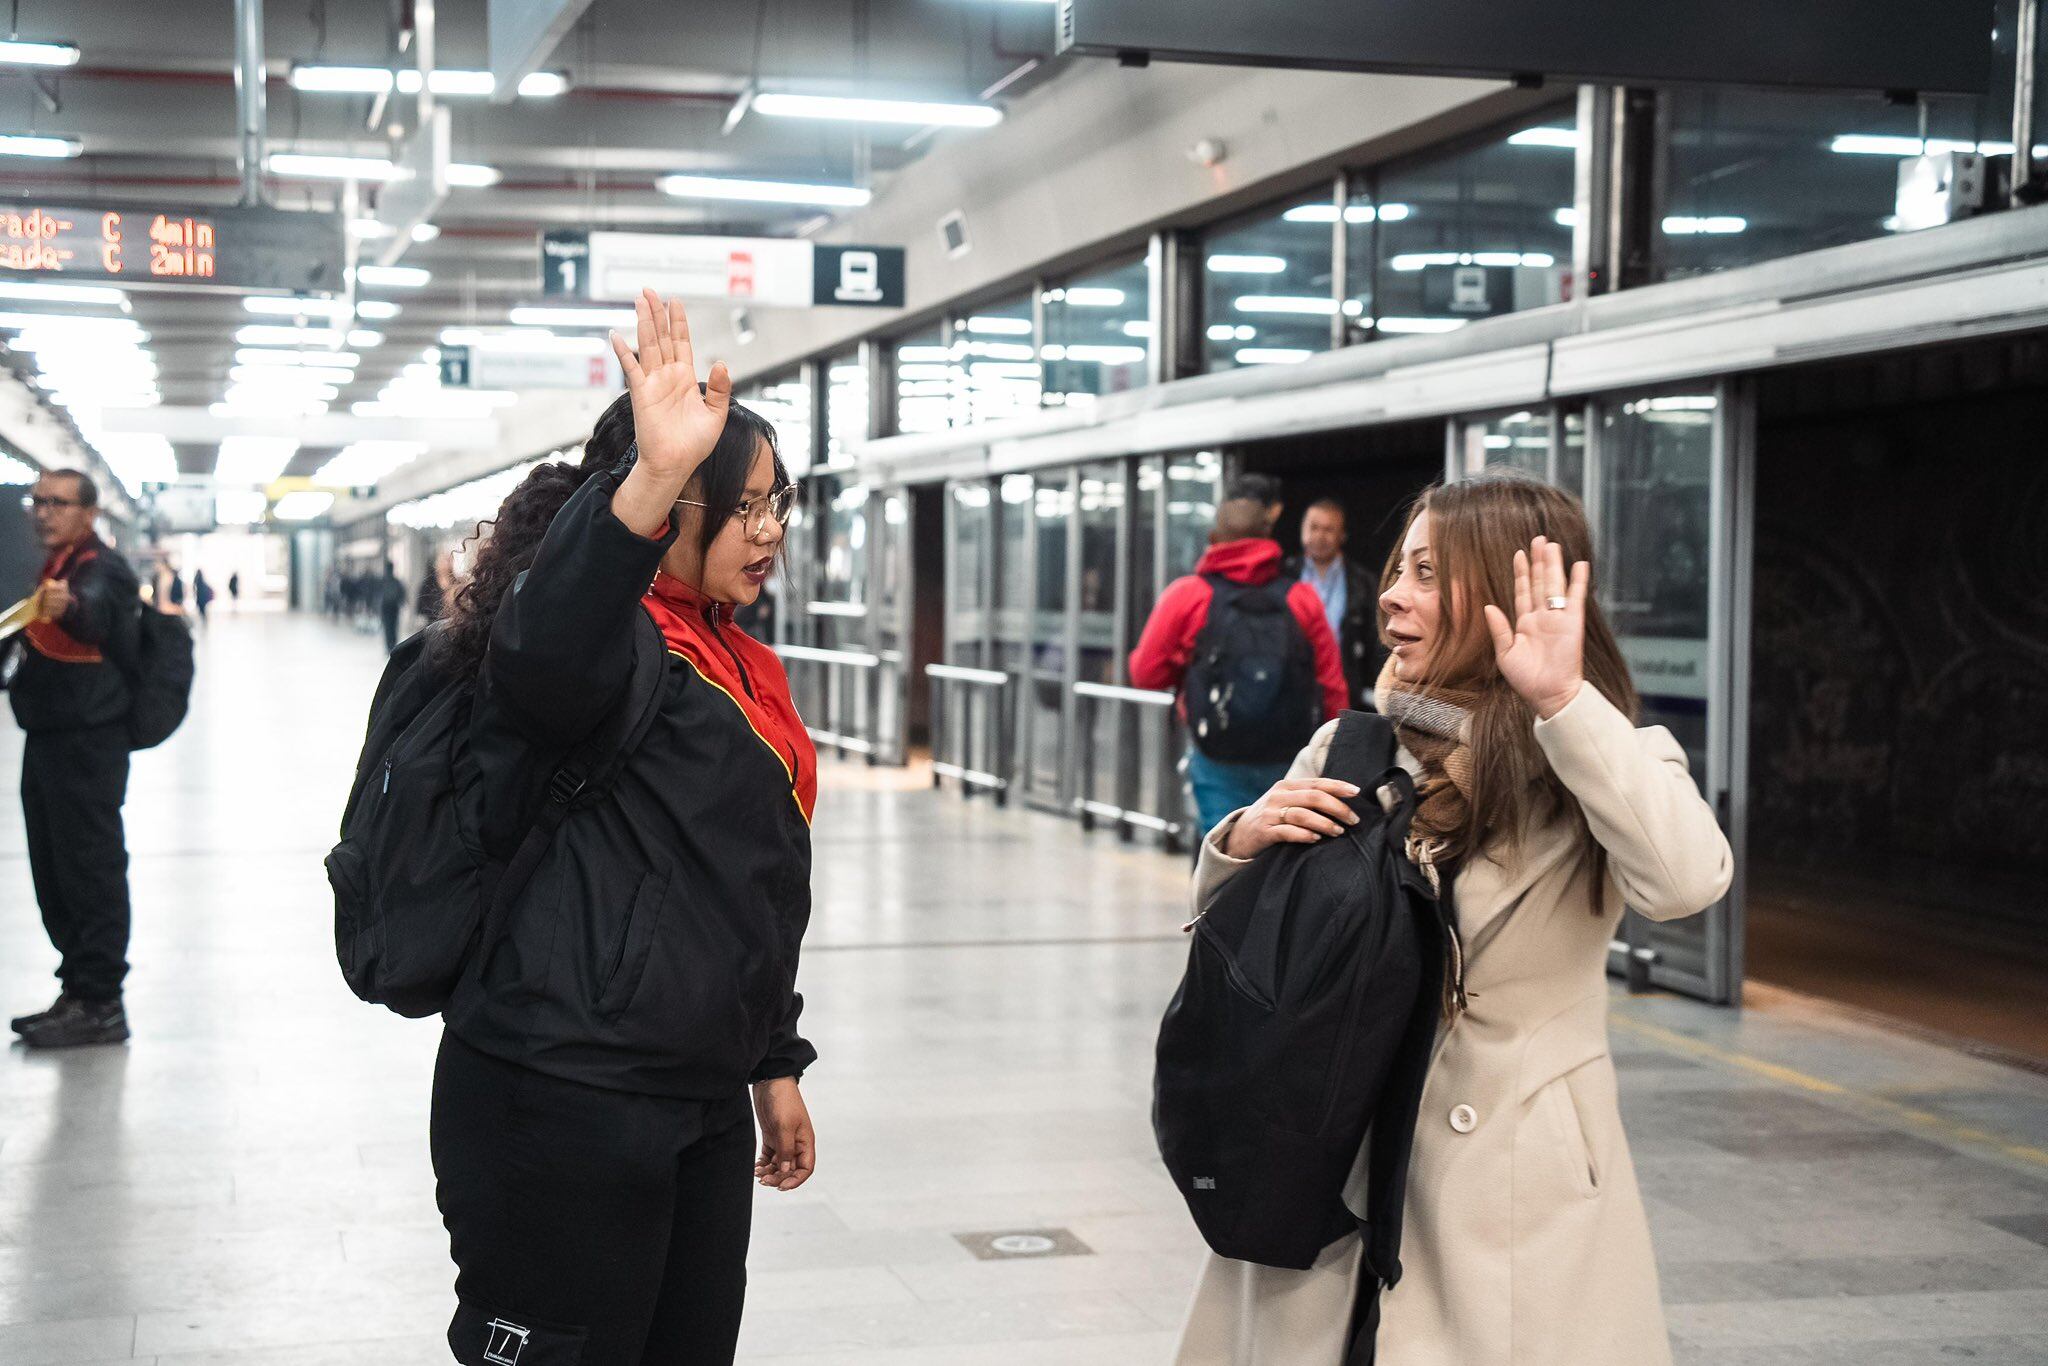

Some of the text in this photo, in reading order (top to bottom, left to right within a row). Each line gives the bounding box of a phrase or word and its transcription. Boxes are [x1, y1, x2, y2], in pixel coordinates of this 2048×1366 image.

[103, 211, 121, 243] C
[150, 214, 214, 247] 4min
[103, 242, 122, 272] C
[151, 244, 214, 277] 2min
[558, 260, 577, 290] 1
